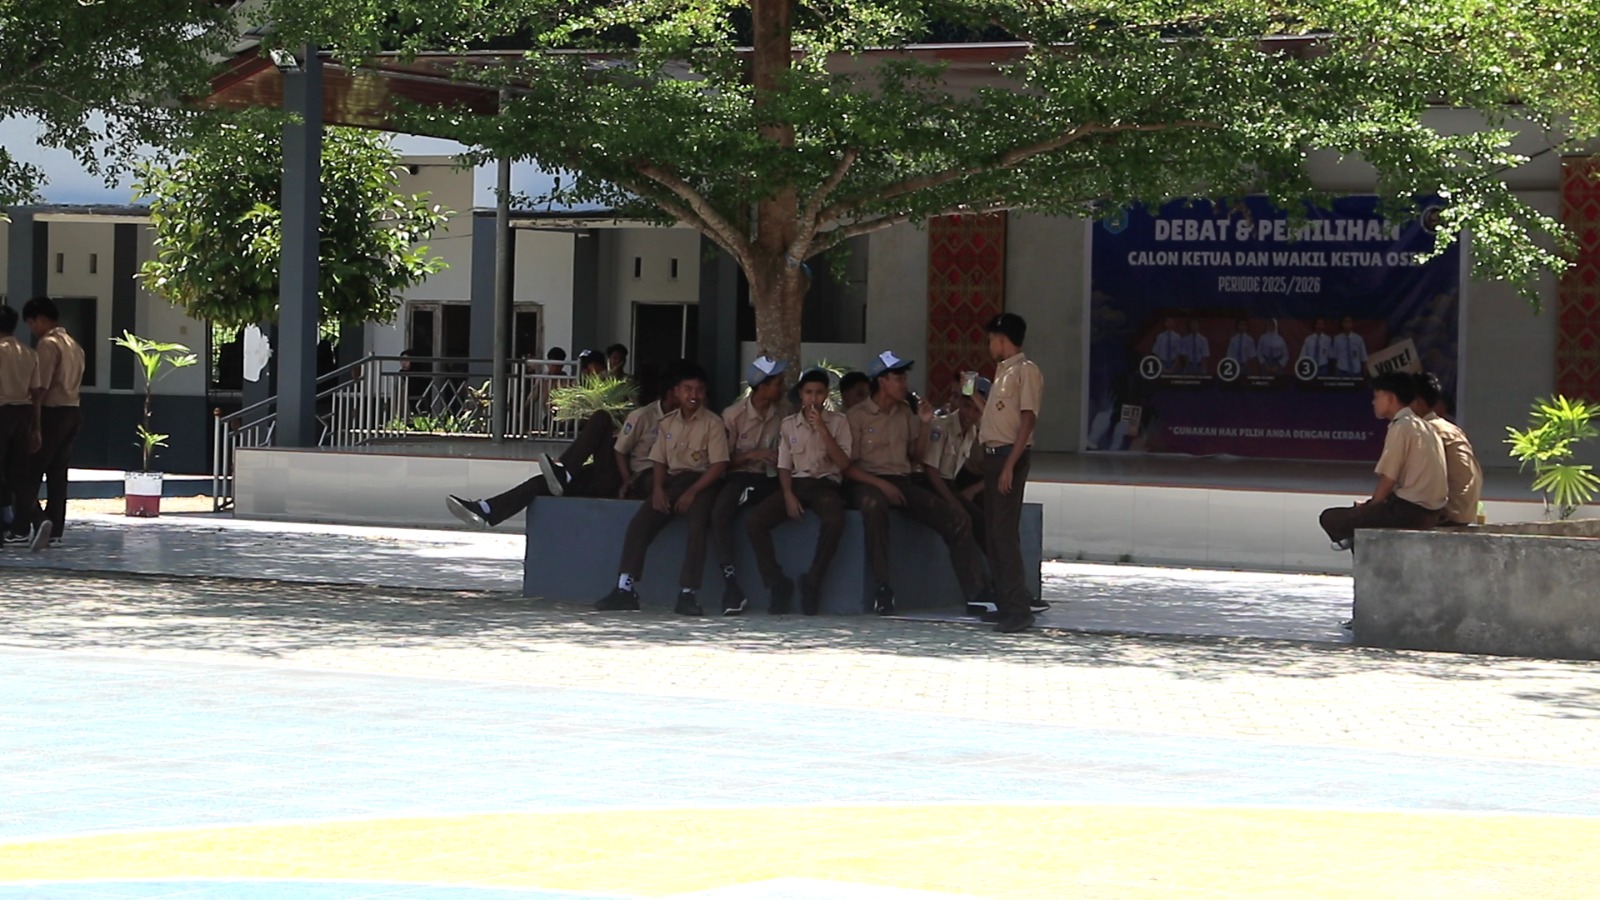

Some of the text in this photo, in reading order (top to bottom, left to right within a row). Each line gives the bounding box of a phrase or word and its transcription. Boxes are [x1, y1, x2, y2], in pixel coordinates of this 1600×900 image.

[1155, 219, 1230, 241] DEBAT
[1235, 219, 1252, 241] &
[1128, 251, 1178, 266] CALON
[1182, 251, 1232, 266] KETUA
[1235, 251, 1269, 266] DAN
[1272, 251, 1327, 266] WAKIL
[1331, 252, 1382, 267] KETUA
[1218, 276, 1321, 295] PERIODE 2025/2026
[1223, 362, 1233, 375] 2
[1301, 362, 1310, 375] 3
[1374, 348, 1411, 374] VOTE!
[1219, 427, 1237, 437] HAK
[1239, 428, 1264, 438] PILIH
[1266, 429, 1291, 438] ANDA
[1293, 429, 1330, 439] DENGAN
